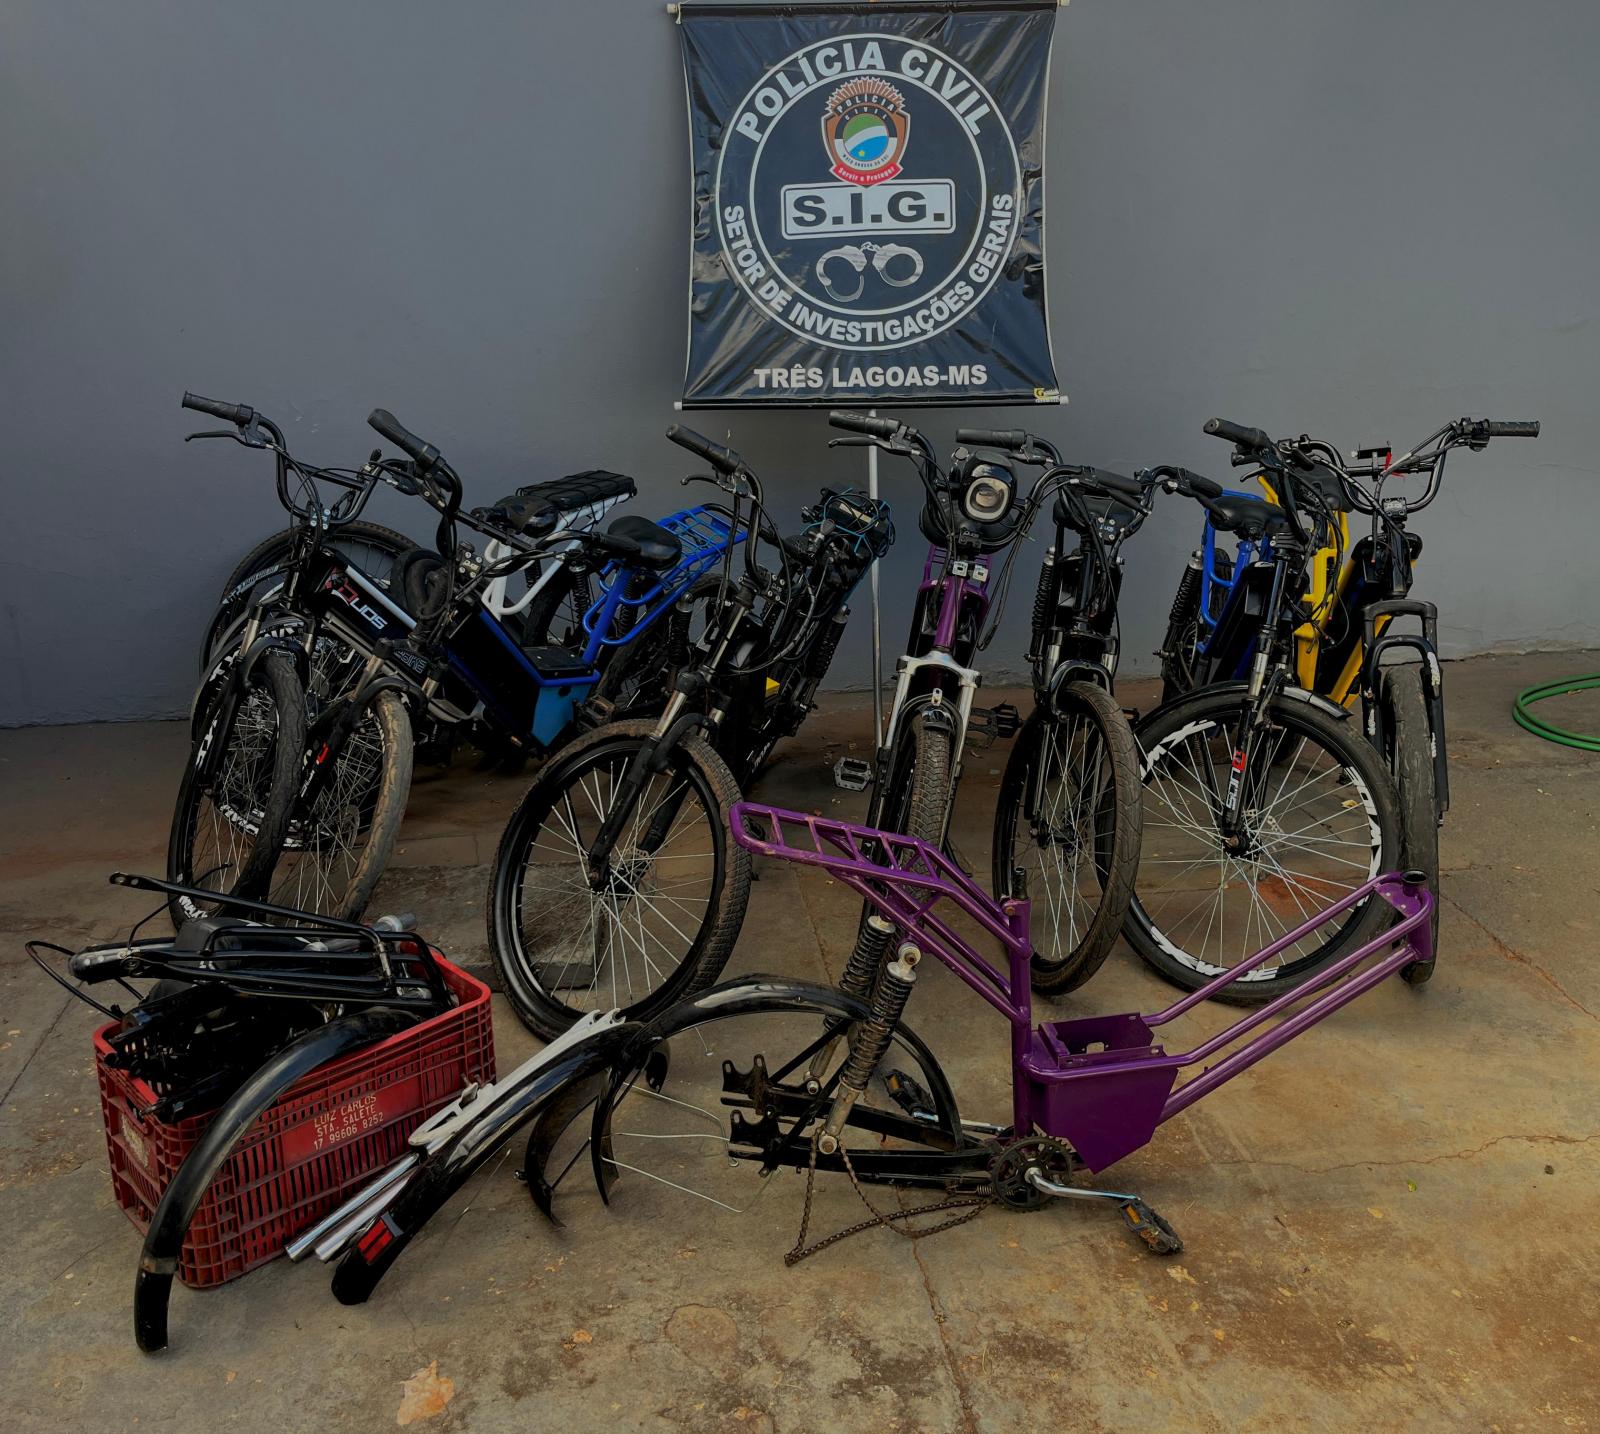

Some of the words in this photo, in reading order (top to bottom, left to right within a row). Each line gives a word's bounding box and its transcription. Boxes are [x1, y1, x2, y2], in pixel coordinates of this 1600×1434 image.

[736, 41, 886, 143] POLÍCIA
[901, 46, 991, 136] CIVIL
[836, 93, 896, 114] POLÍCIA
[845, 106, 887, 121] CIVIL
[792, 190, 945, 228] S.I.G.
[724, 205, 760, 286] SETOR
[758, 282, 794, 313] DE
[788, 279, 976, 343] INVESTIGAÇÕES
[968, 192, 1013, 283] GERAIS
[754, 363, 824, 389] TRÊS
[832, 364, 987, 388] LAGOAS-MS
[314, 1110, 337, 1128] LUIZ
[341, 1096, 377, 1116] CARLOS
[343, 1104, 376, 1126] SALETE
[314, 1138, 324, 1150] 17
[329, 1124, 358, 1143] 99606
[362, 1111, 384, 1129] 8252
